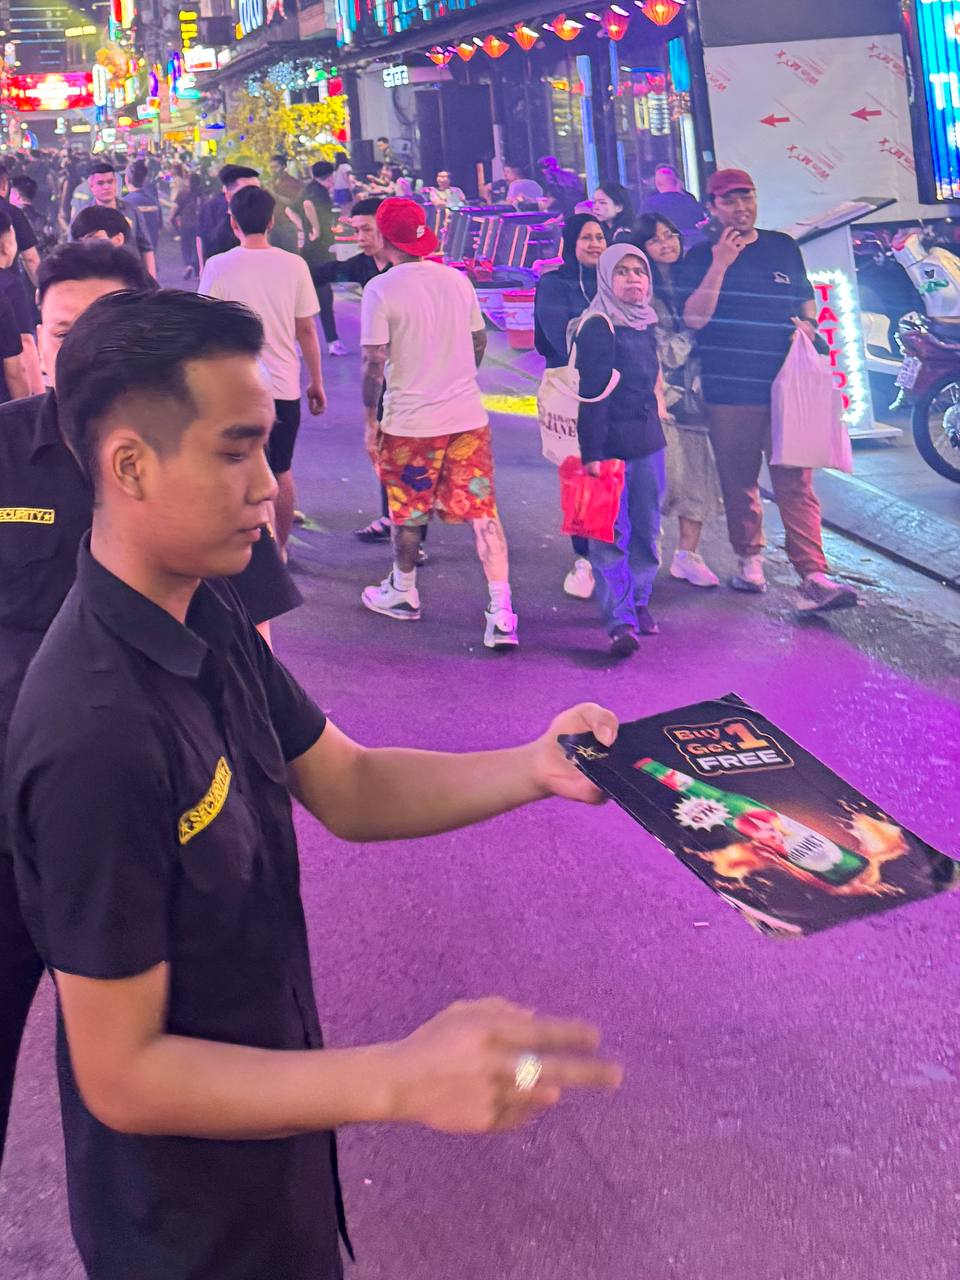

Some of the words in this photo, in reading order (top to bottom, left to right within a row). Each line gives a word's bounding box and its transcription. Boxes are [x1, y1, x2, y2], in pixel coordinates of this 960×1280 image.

[672, 727, 721, 741] Buy
[724, 722, 770, 750] 1
[686, 741, 737, 755] Get
[696, 749, 784, 771] FREE
